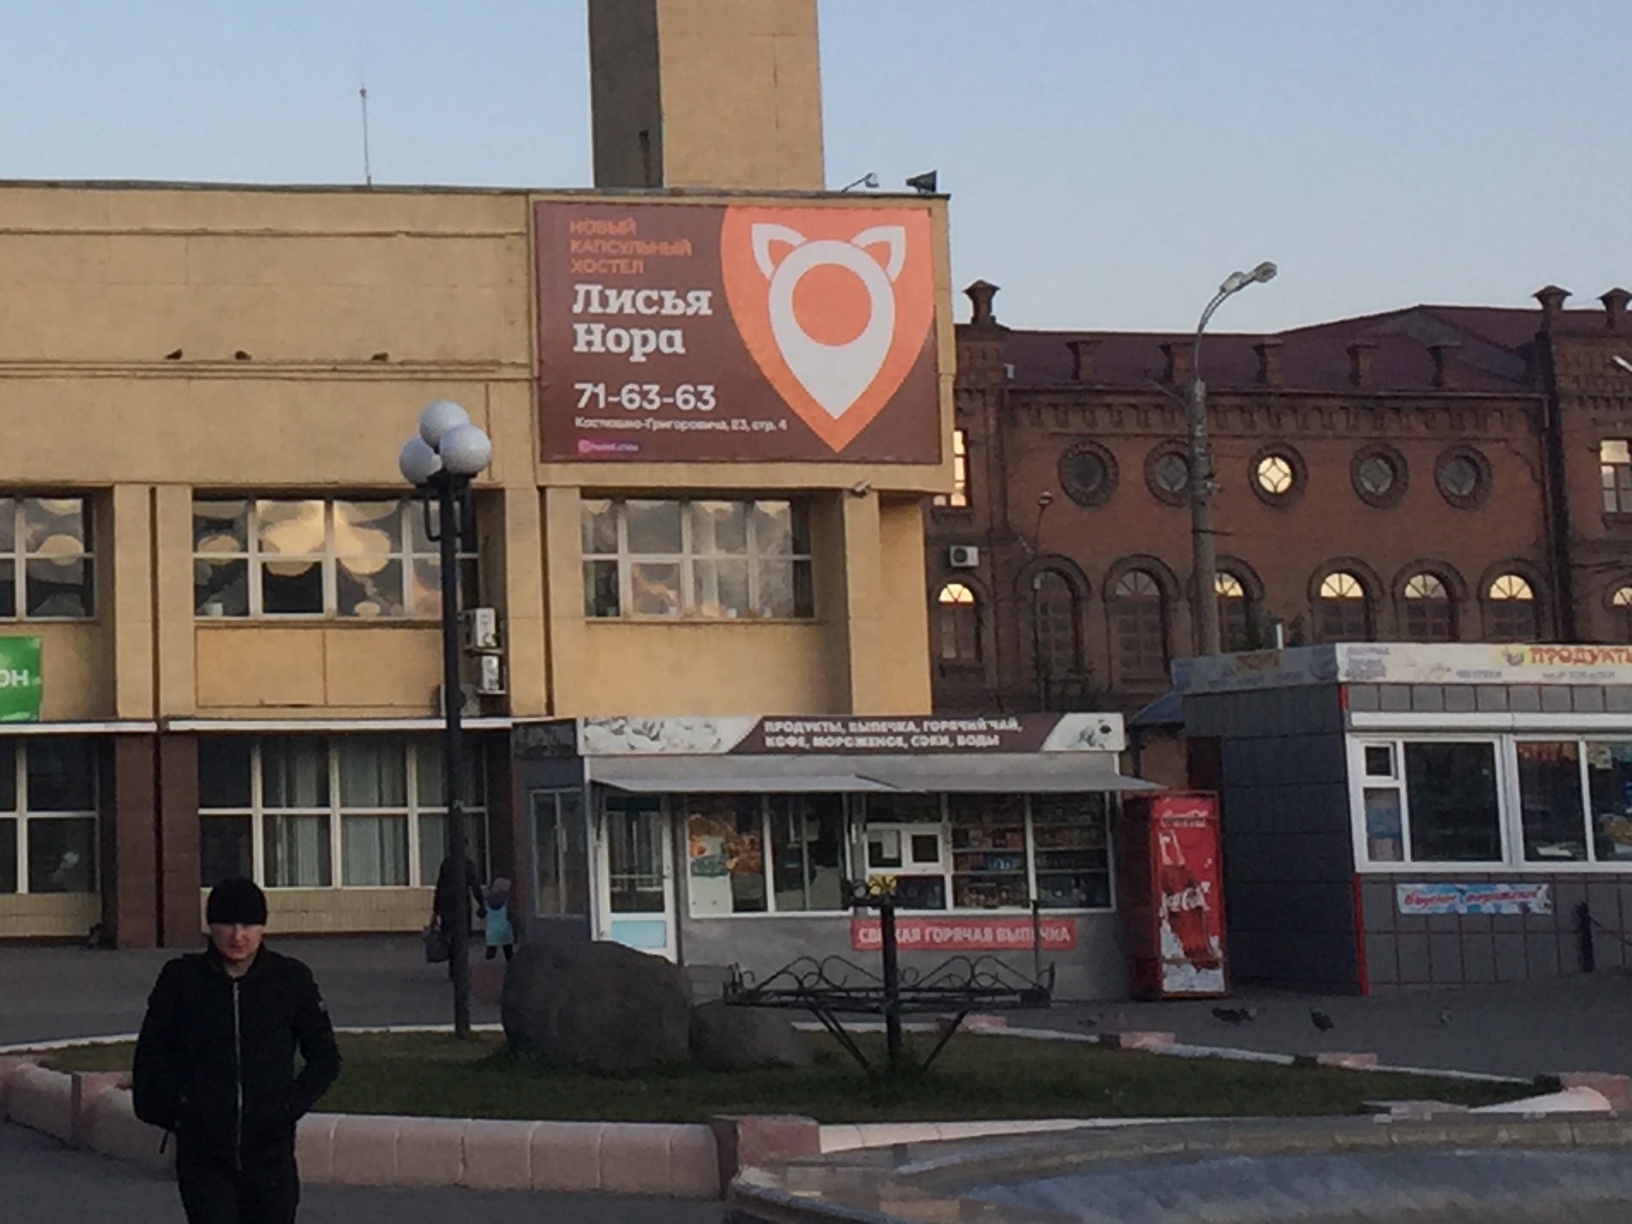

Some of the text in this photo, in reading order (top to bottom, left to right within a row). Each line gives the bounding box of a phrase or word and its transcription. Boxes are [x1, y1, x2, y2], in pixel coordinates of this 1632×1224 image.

[570, 217, 637, 235] НОВЫЙ
[570, 238, 692, 256] КАПСУЛЬНЫЙ
[570, 259, 644, 274] ХОСТЕЛ
[572, 284, 712, 316] Лисья
[573, 323, 685, 362] Нора
[574, 383, 716, 411] 71-63-63
[764, 716, 1023, 735] ПРОДУКТЫ, ВЫПЕЧКА, ГОРЯЧИЙ ЧАЙ,
[765, 735, 1000, 749] КОФЕ, МОРОЖЕНОЕ, СОКИ, ВОДЫ
[925, 926, 993, 943] ГОРЯЧАЯ
[996, 926, 1071, 943] ВЫПЧКА
